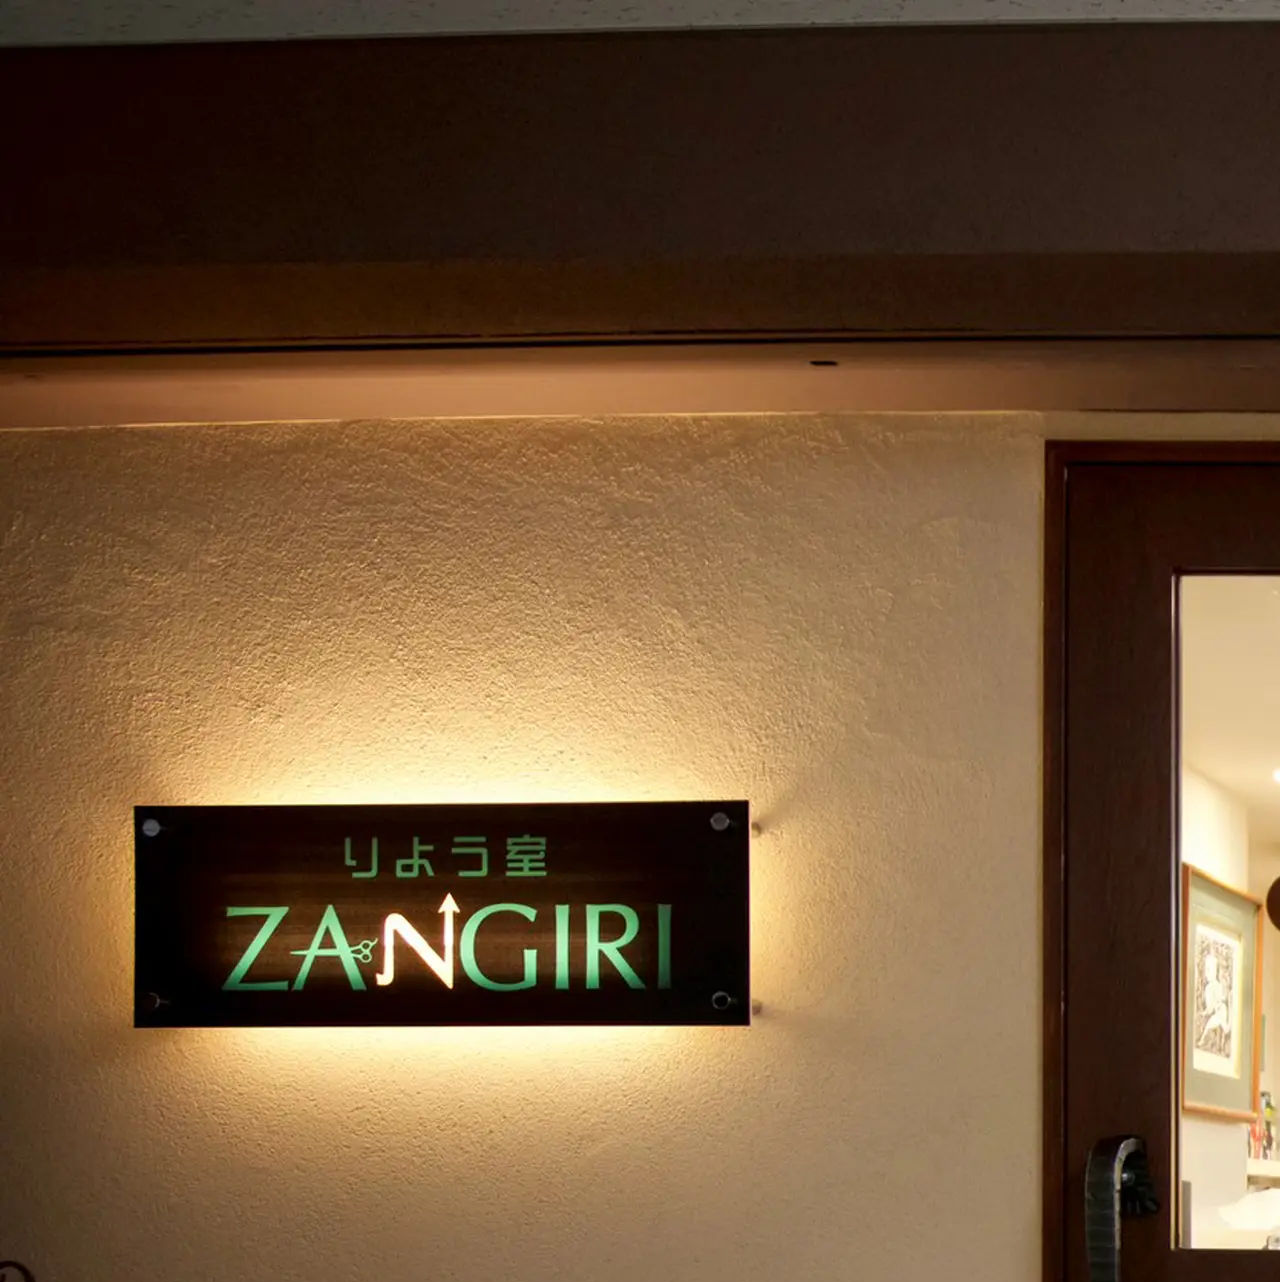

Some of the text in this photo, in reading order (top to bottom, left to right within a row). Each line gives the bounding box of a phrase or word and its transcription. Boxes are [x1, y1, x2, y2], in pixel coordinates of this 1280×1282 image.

[344, 835, 547, 879] りよう室
[222, 893, 671, 992] ZANGIRI
